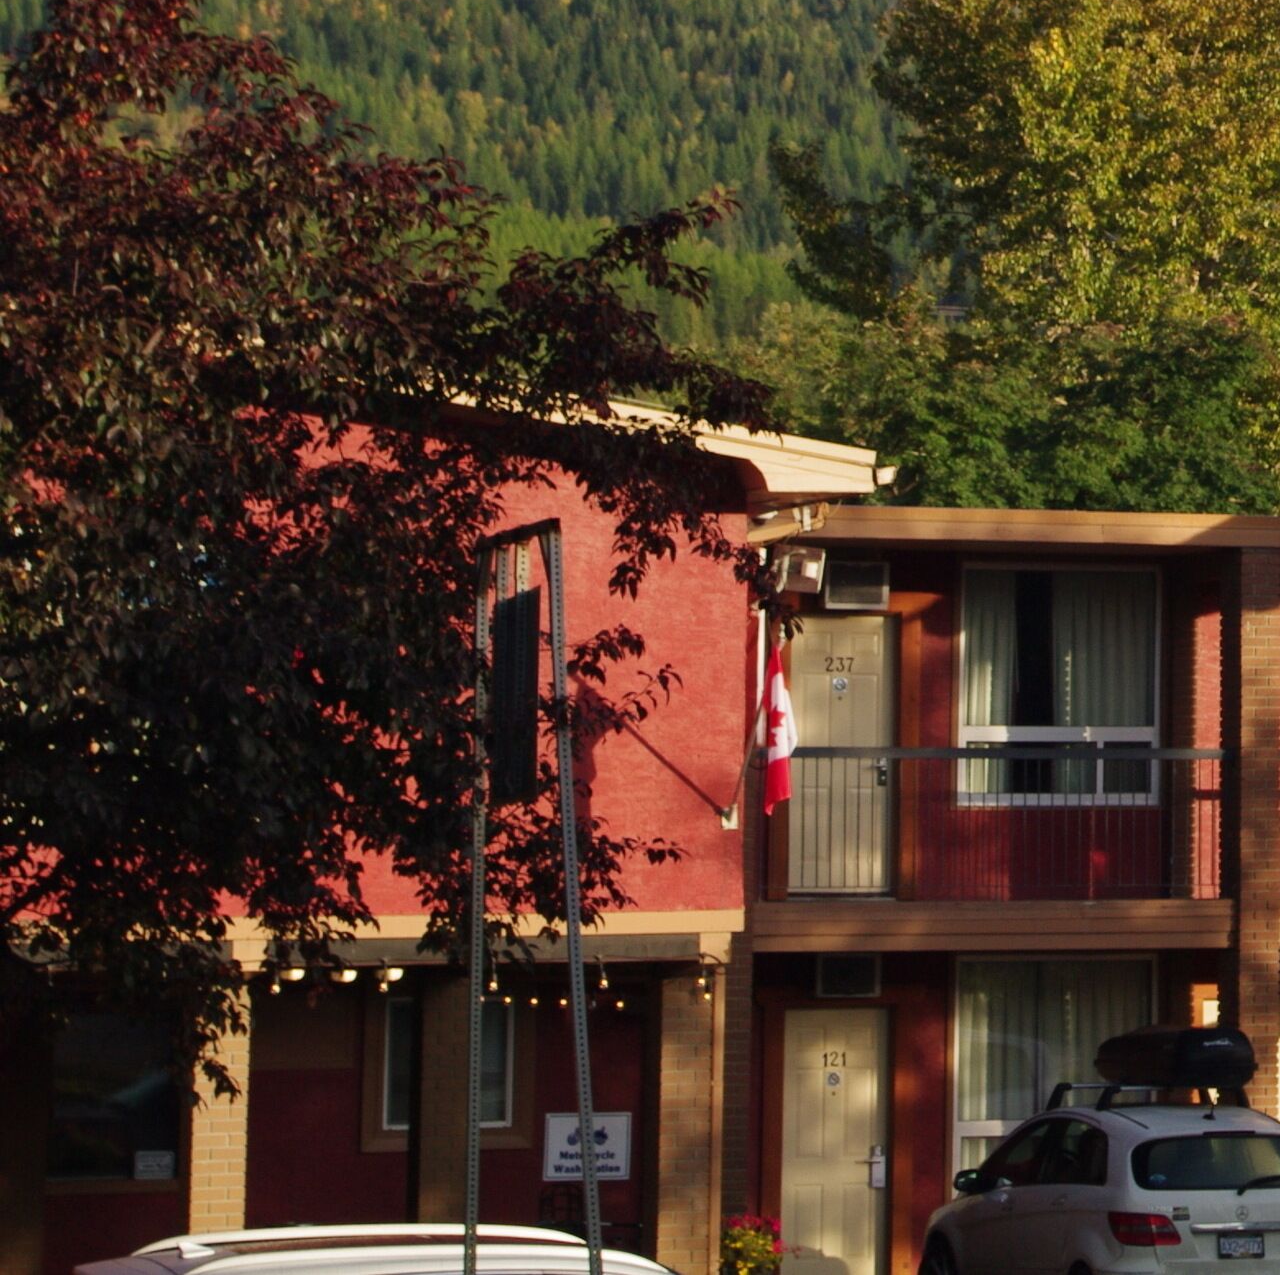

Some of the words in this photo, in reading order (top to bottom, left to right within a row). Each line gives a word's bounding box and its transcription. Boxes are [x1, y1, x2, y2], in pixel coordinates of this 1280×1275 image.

[824, 656, 855, 673] 237
[823, 1051, 846, 1068] 121
[559, 1150, 615, 1161] Motoycle
[553, 1164, 582, 1173] Wash
